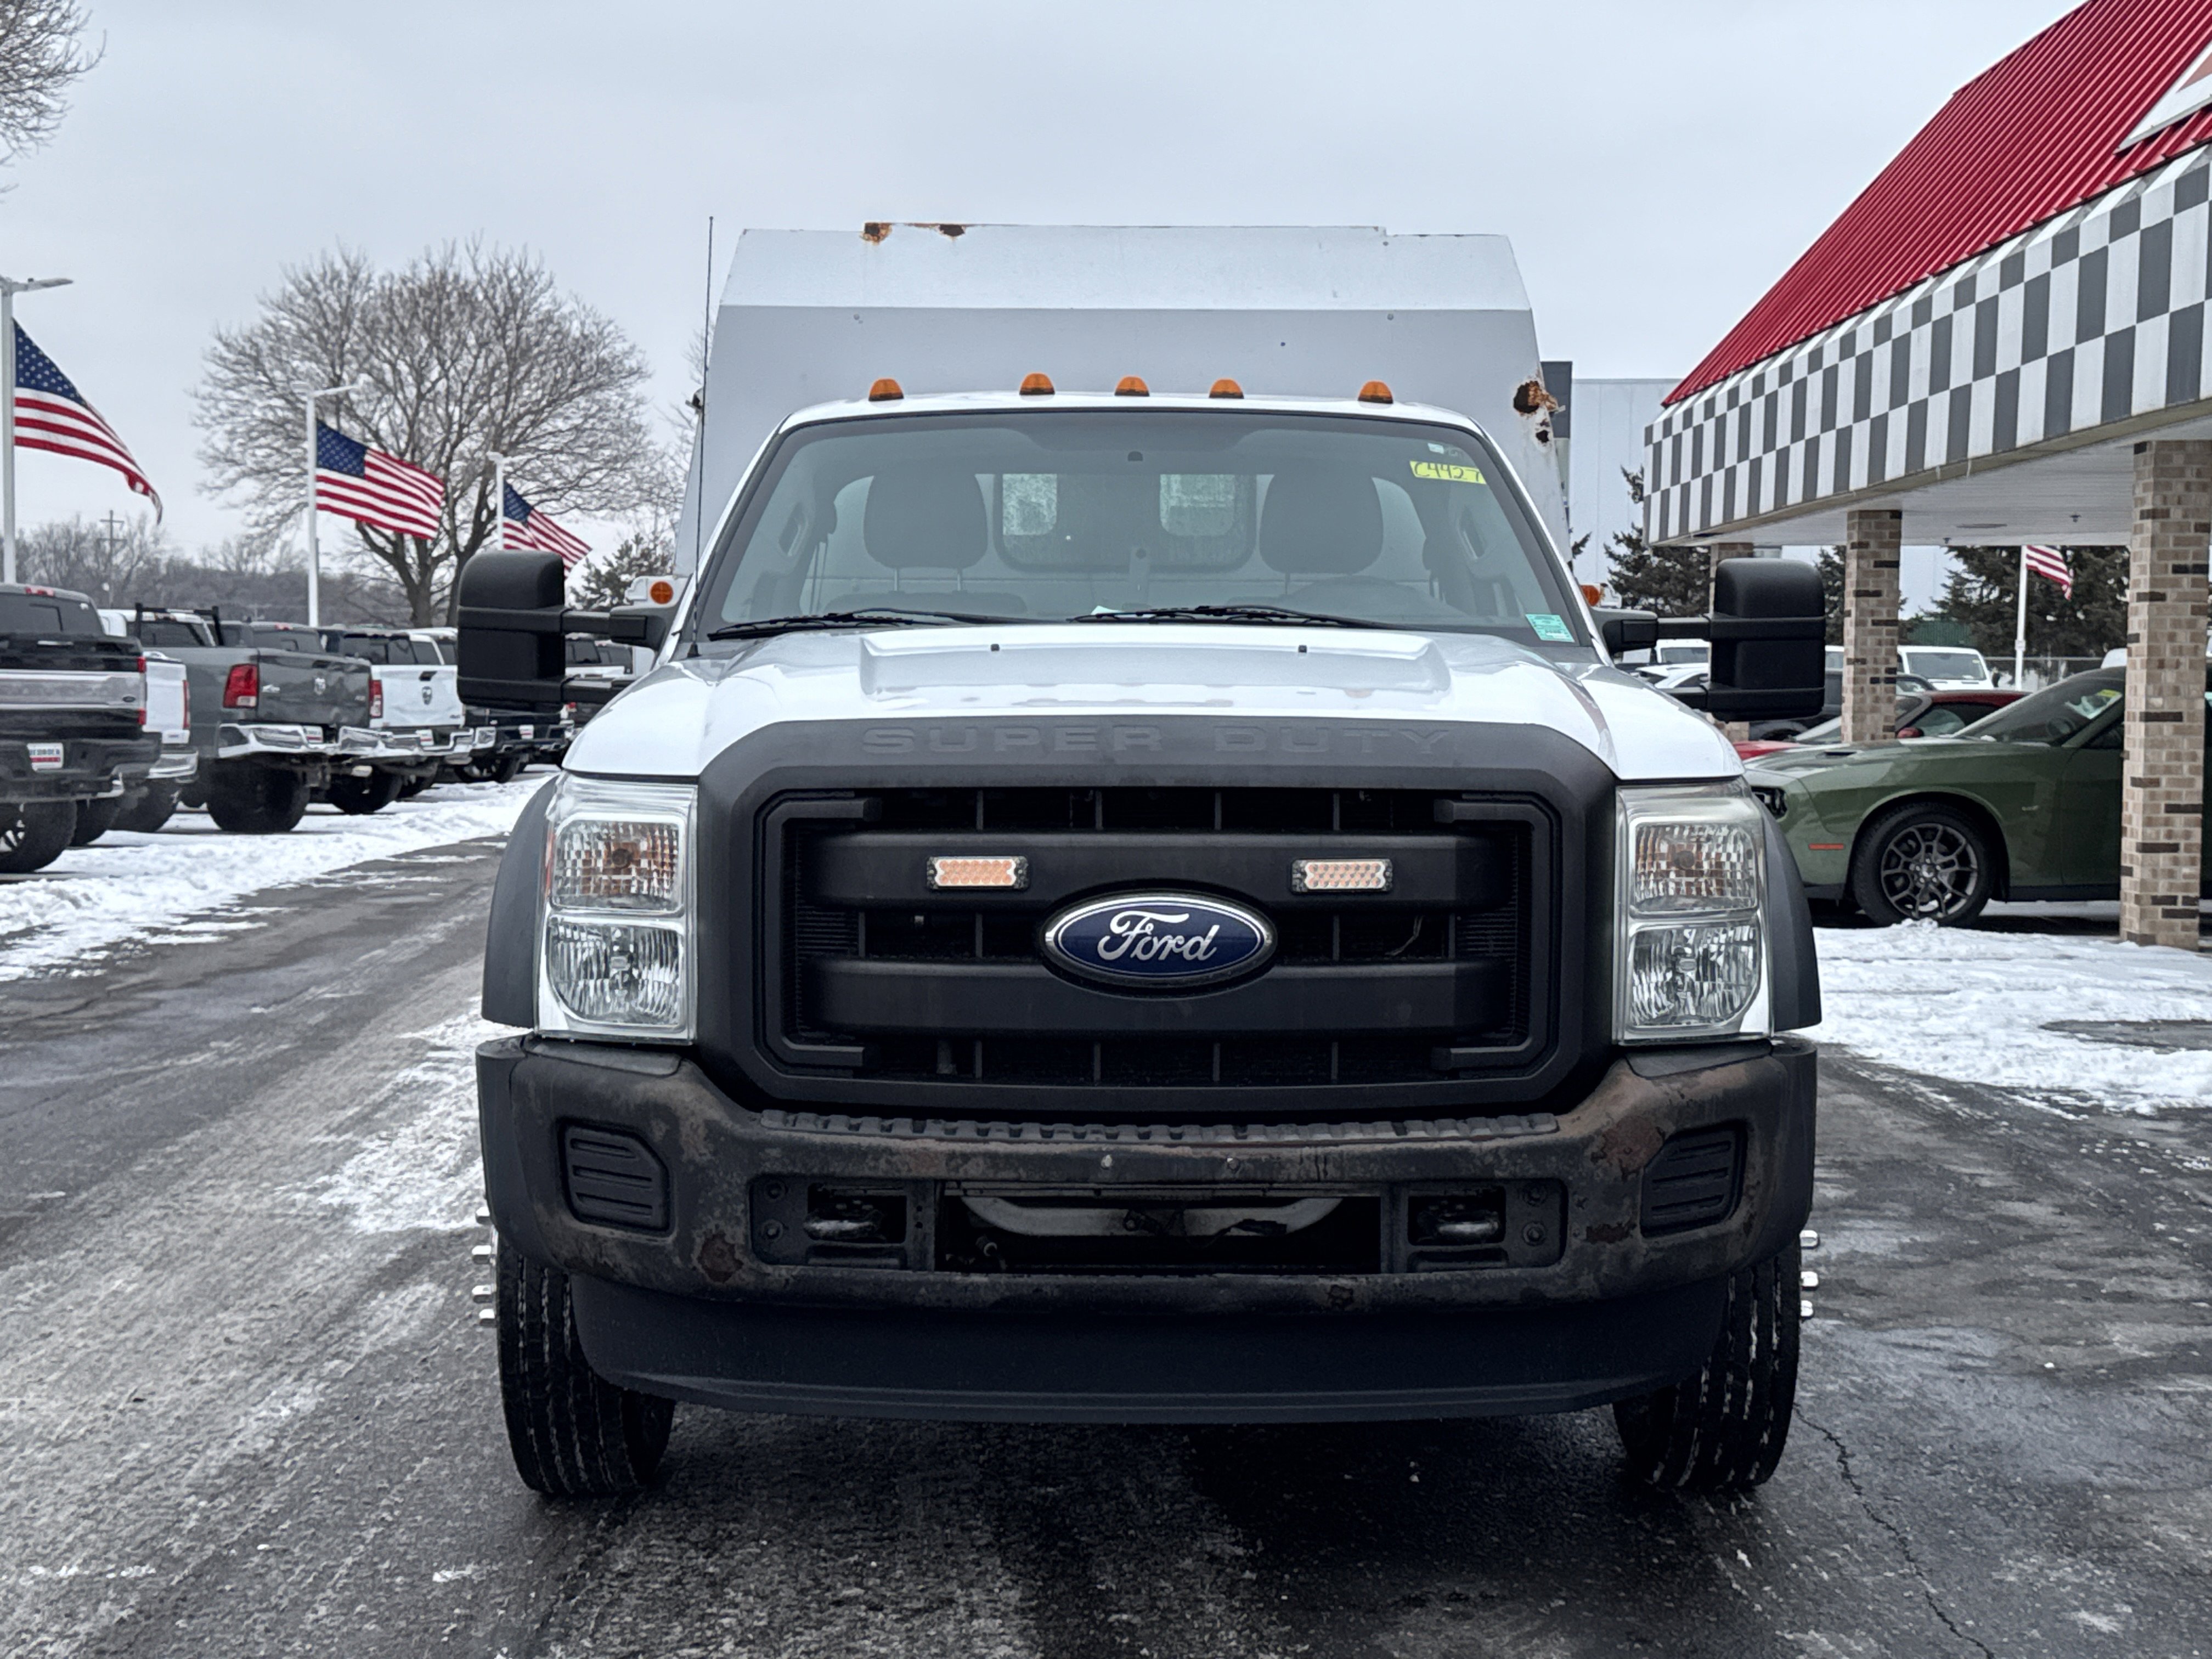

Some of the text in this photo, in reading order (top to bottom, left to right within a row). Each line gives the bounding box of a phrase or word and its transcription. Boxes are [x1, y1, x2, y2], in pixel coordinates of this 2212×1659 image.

[862, 725, 1449, 754] SUPER DUTY
[1097, 910, 1220, 961] Ford
